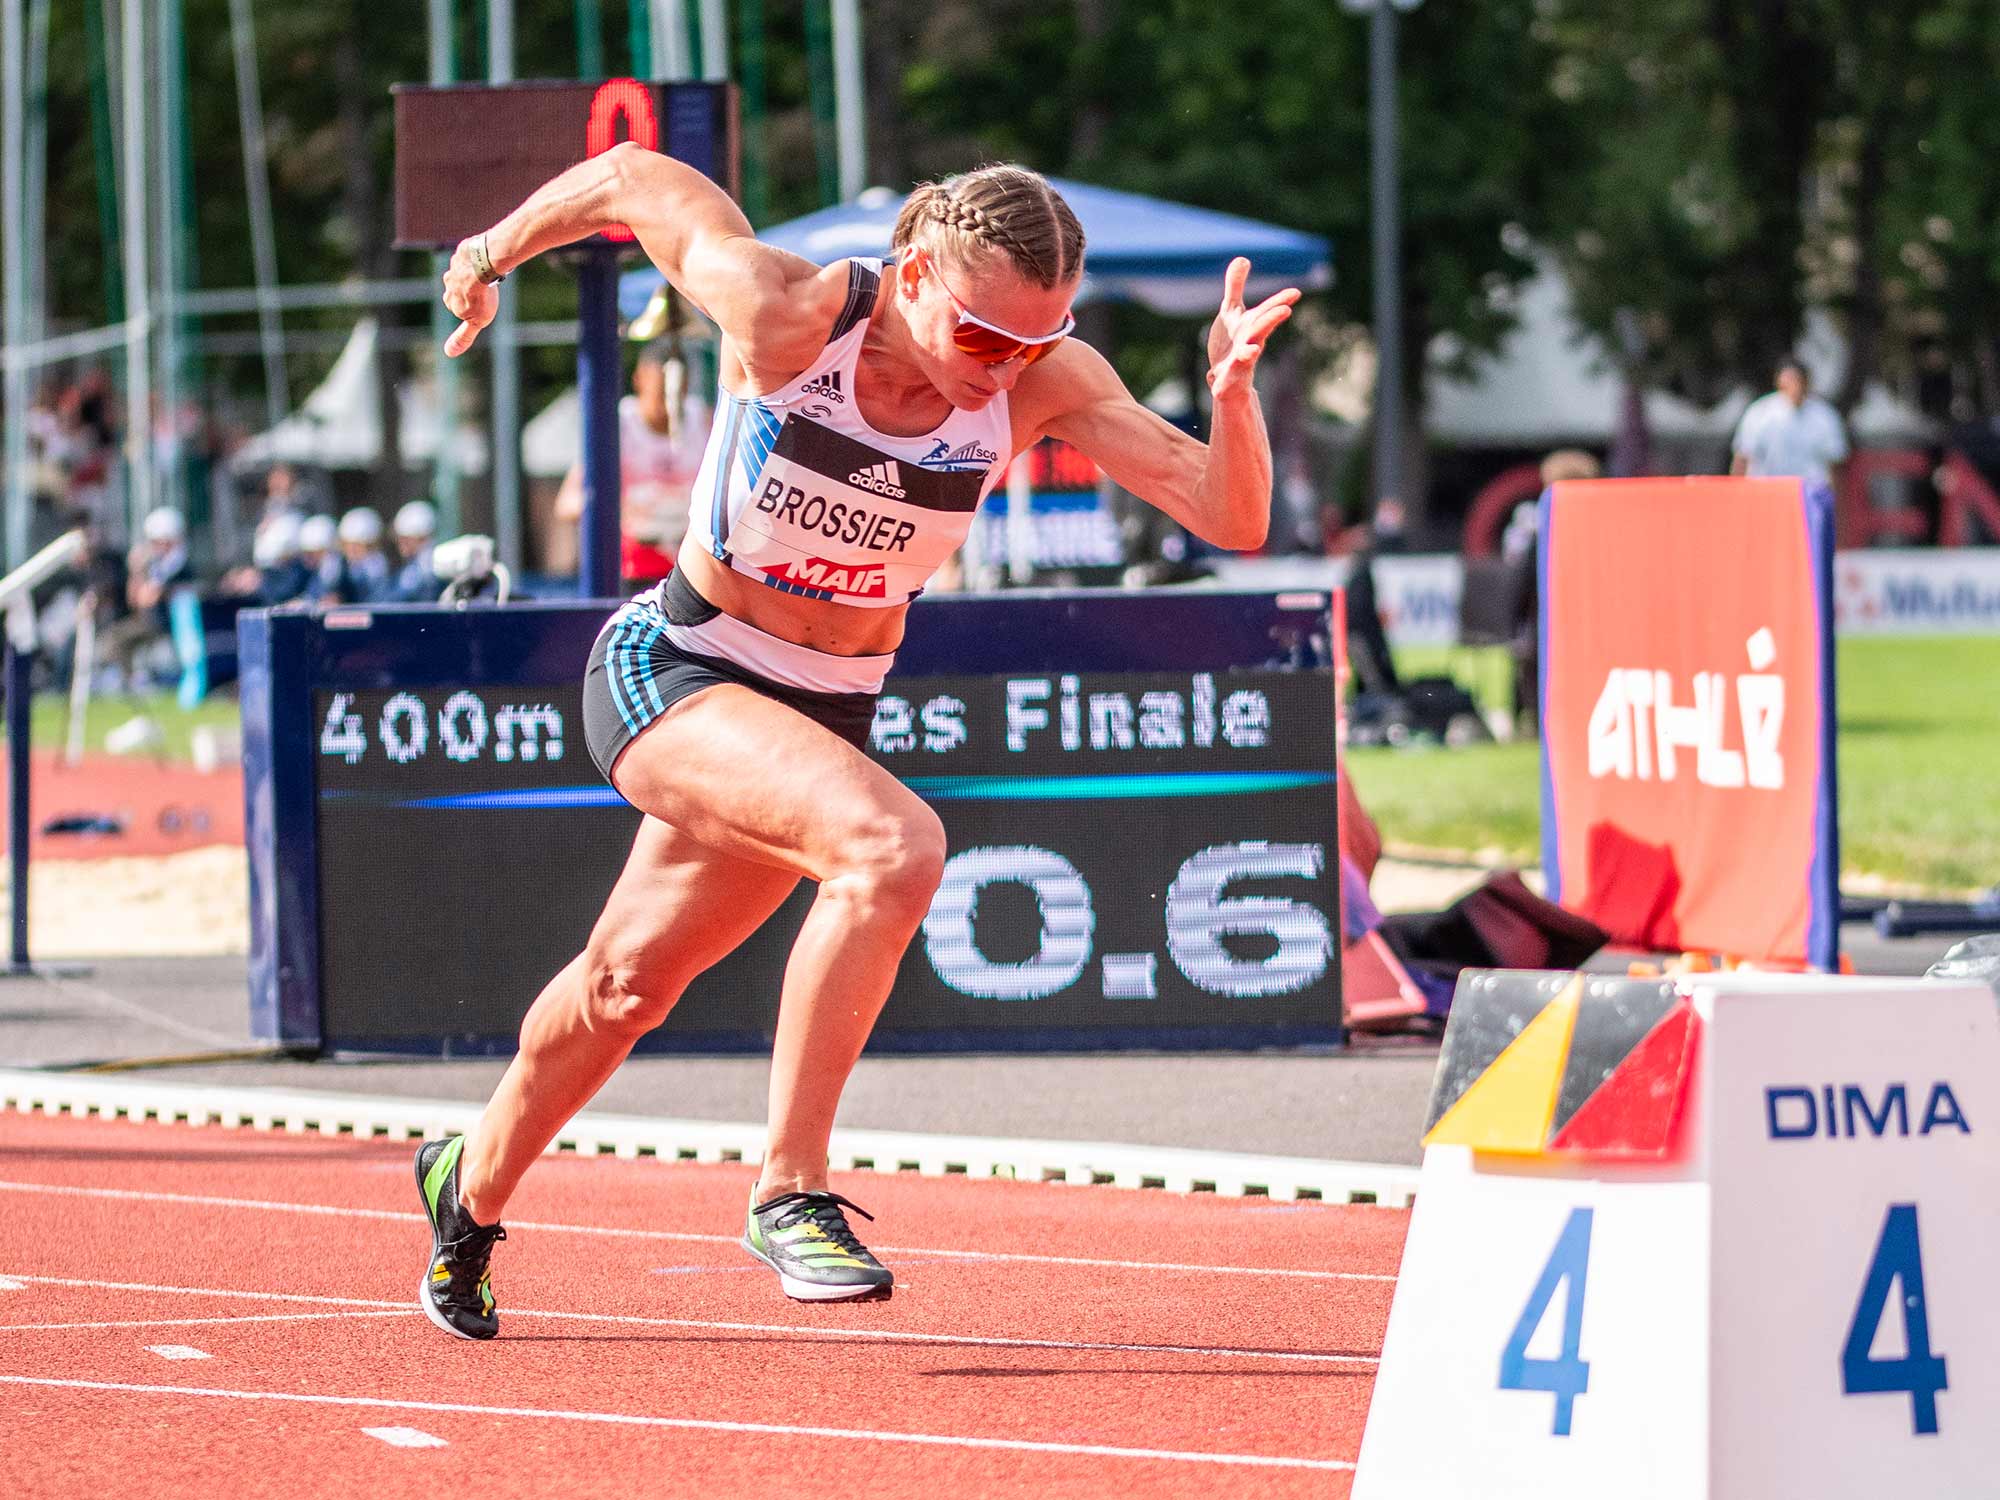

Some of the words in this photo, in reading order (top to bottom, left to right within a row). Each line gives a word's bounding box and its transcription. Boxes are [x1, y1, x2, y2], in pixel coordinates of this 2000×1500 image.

[801, 384, 845, 404] adidas
[756, 477, 916, 552] BROSSIER
[848, 472, 906, 498] adidas
[785, 559, 885, 593] MAIF
[320, 691, 564, 764] 400m
[870, 696, 968, 753] es
[1005, 673, 1271, 752] Finale
[922, 840, 1334, 1000] 0.6
[1764, 1082, 1972, 1141] DIMA
[1497, 1207, 1594, 1436] 4
[1841, 1202, 1949, 1436] 4
